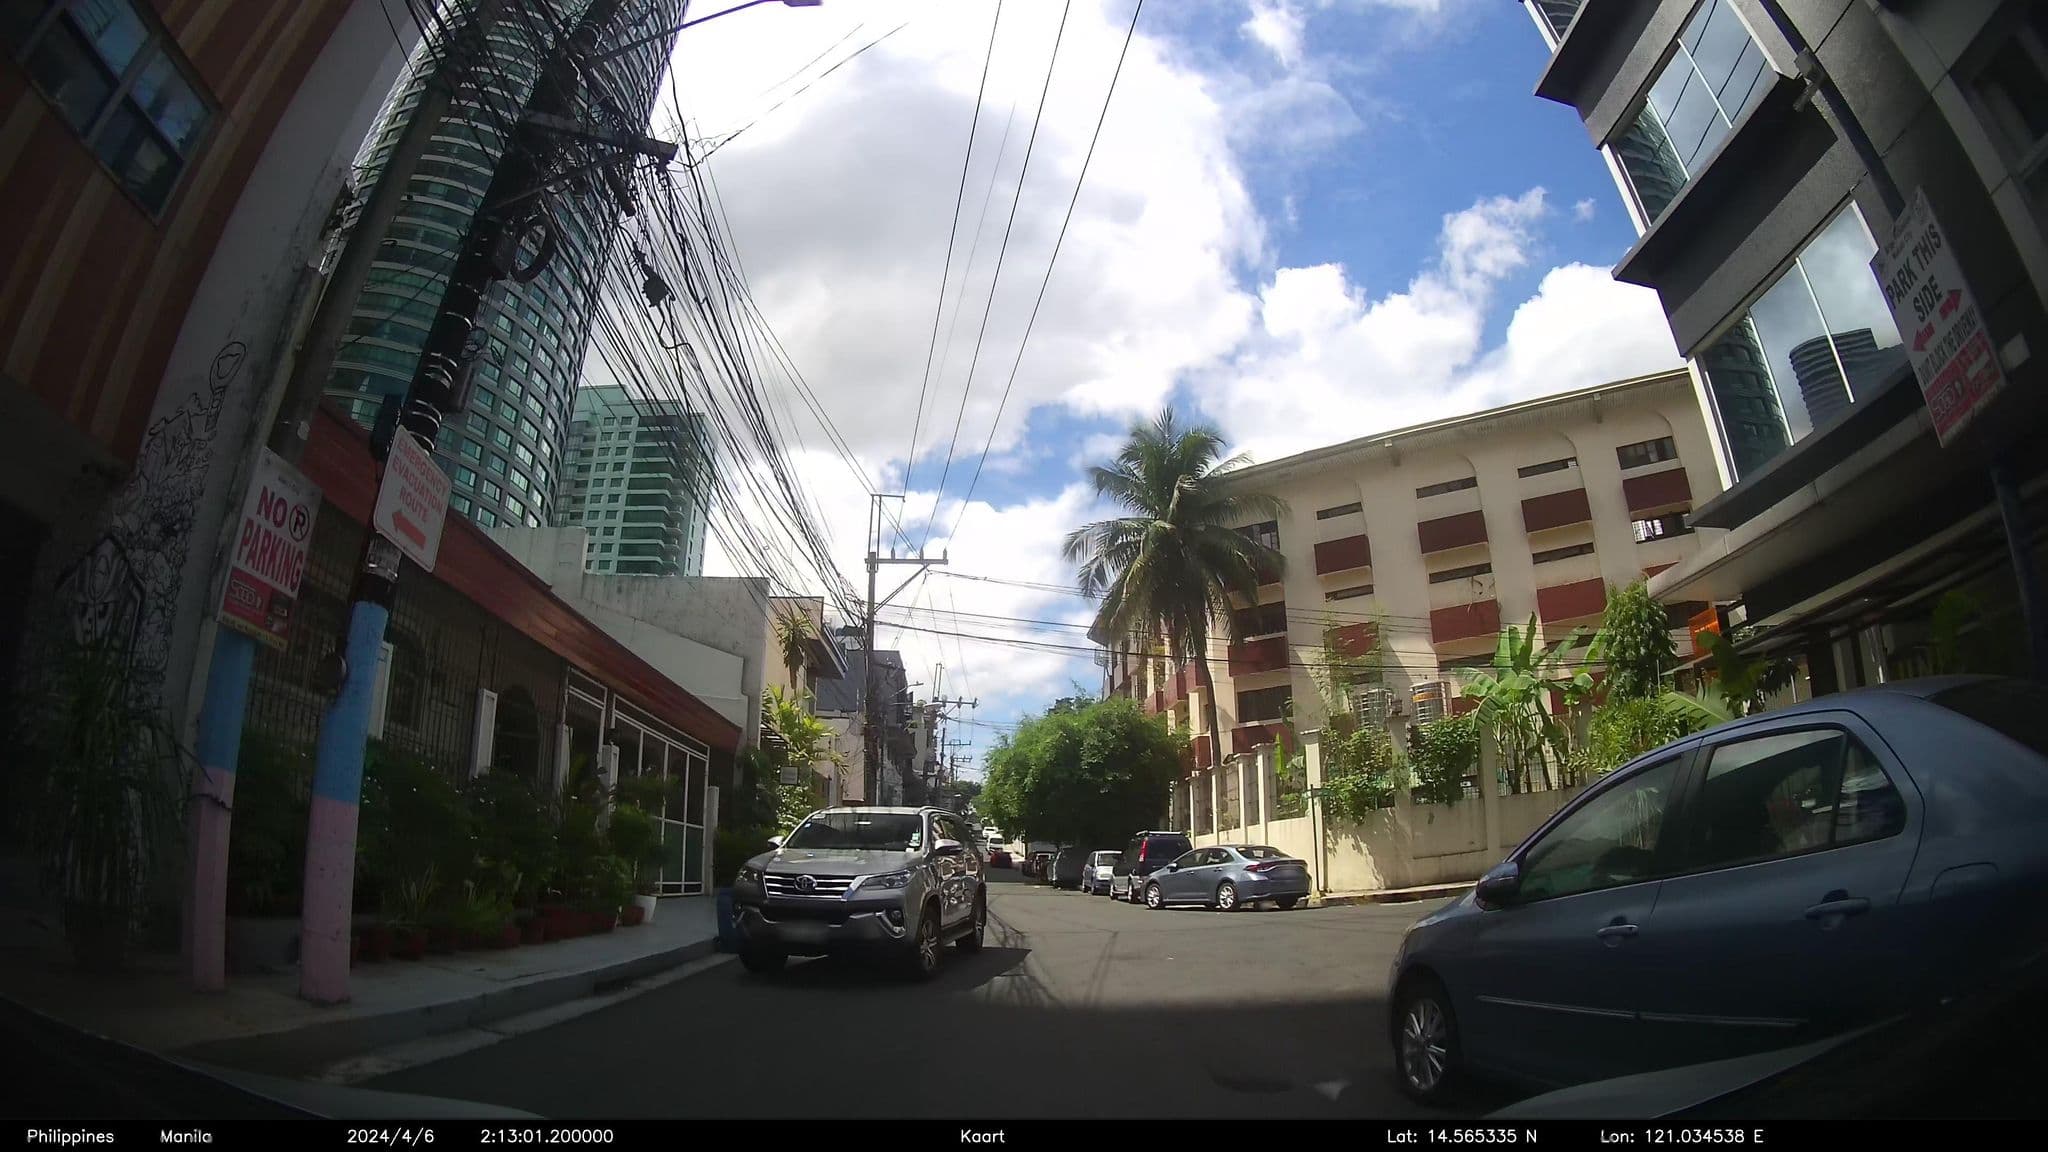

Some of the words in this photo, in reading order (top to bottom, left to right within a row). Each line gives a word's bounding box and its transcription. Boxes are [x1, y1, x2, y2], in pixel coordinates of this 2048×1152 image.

[1886, 256, 1918, 310] PARK
[1912, 223, 1942, 272] THIS
[1913, 274, 1943, 322] SIDE
[392, 455, 444, 514] EVACUATION
[398, 439, 447, 495] EMERGENCY
[256, 485, 288, 529] NO
[399, 487, 429, 521] ROUTE
[237, 517, 305, 592] PARKING
